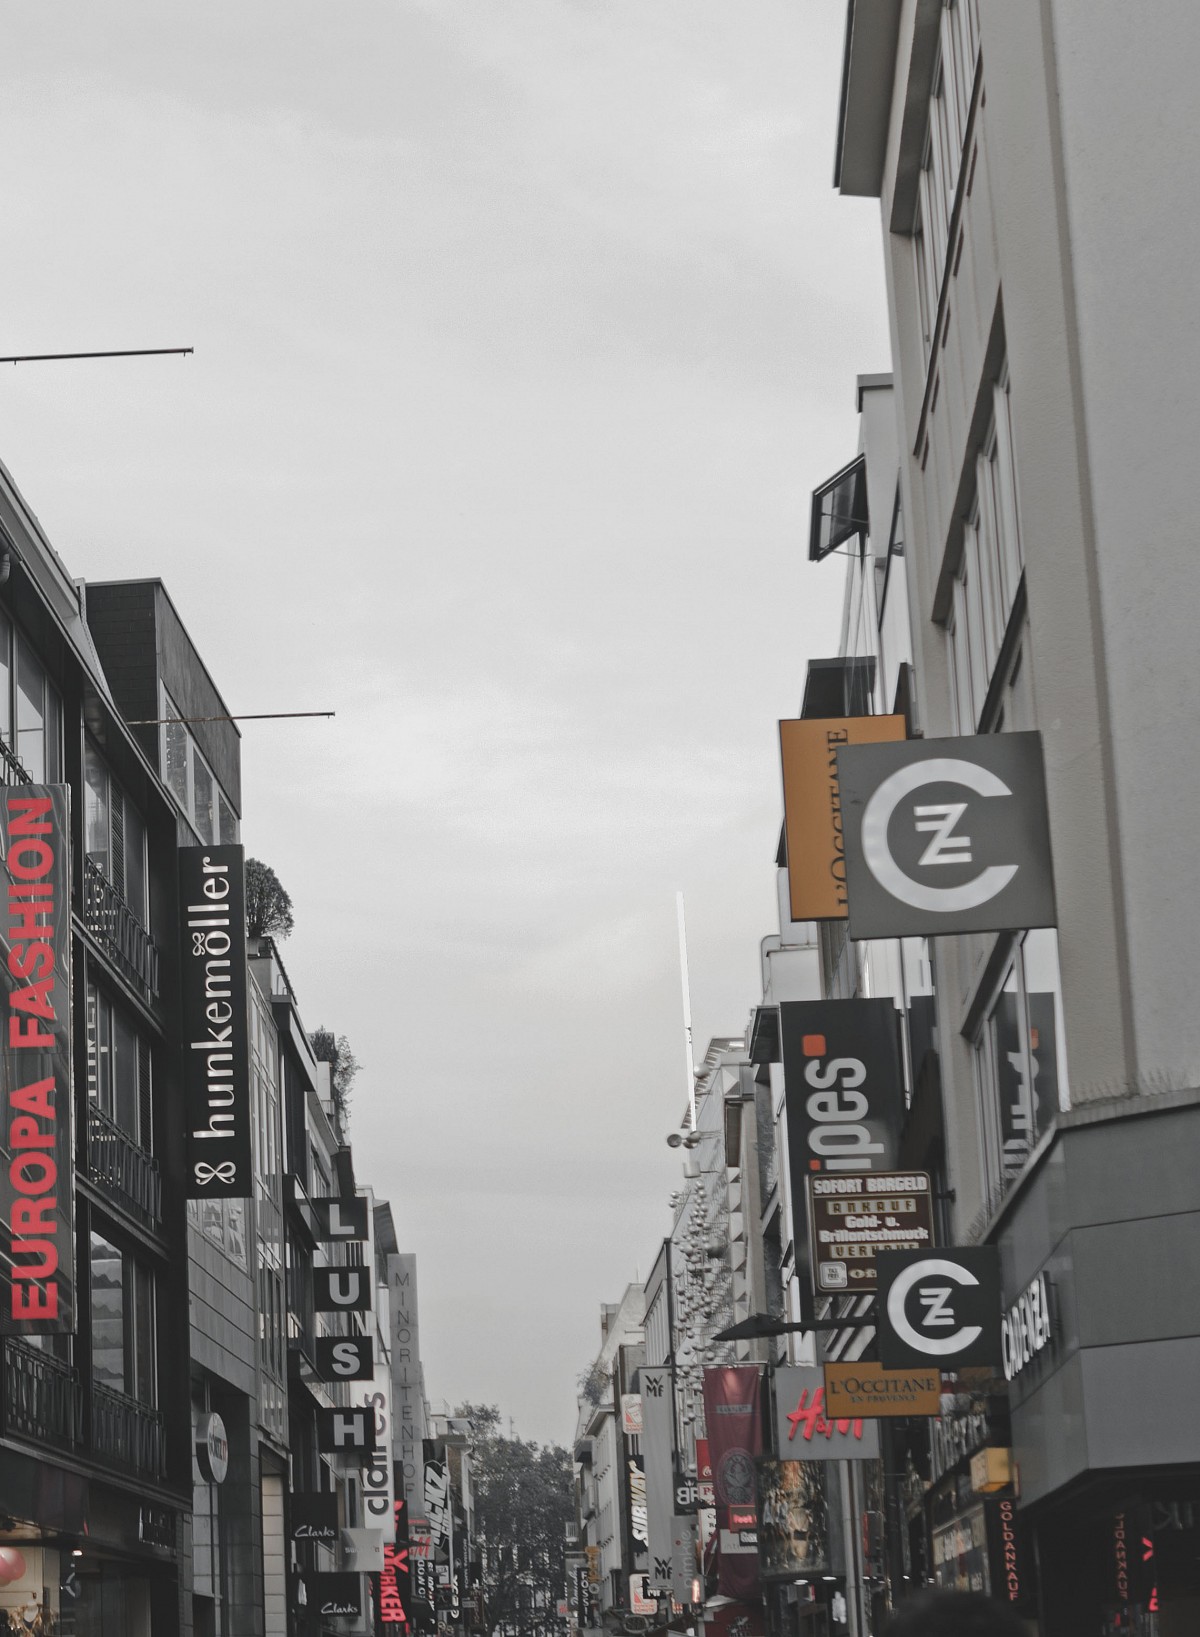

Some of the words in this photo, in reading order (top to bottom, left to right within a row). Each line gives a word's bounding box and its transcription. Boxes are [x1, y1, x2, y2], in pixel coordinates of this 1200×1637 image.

[7, 797, 56, 1049] FASHION
[813, 1178, 863, 1194] SOFORT
[865, 1176, 928, 1192] BARGELD
[9, 1075, 59, 1320] EUROPA
[833, 1200, 913, 1213] ANKAUF
[844, 1215, 883, 1228] Gold-
[885, 1216, 900, 1227] u.
[328, 1203, 366, 1446] LUSH
[830, 1377, 936, 1394] L'OCCITANE
[628, 1459, 649, 1547] SUBWAY
[294, 1525, 336, 1538] Clarks
[1000, 1501, 1019, 1602] GOLDANKAUF
[320, 1601, 359, 1615] Clarks
